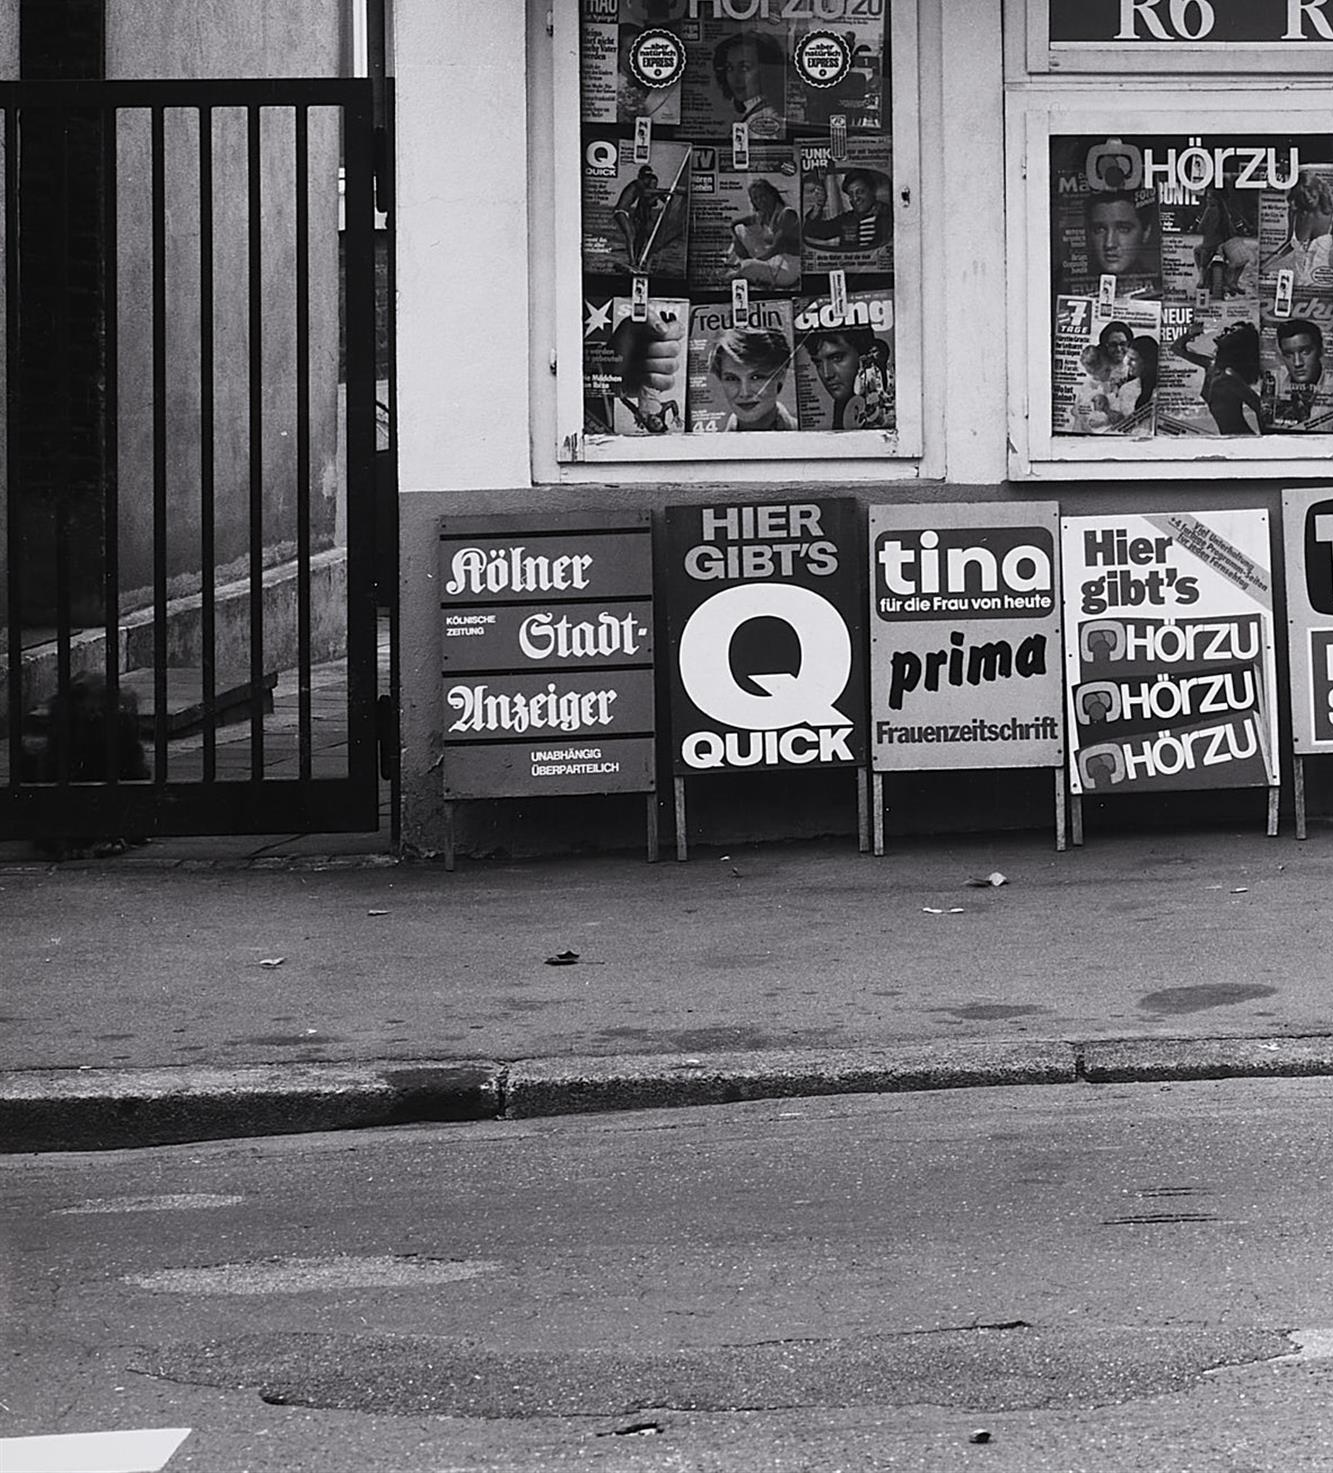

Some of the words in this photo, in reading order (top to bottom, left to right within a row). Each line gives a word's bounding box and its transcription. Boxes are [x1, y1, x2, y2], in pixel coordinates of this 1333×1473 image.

[690, 302, 783, 337] freudin
[1060, 325, 1088, 334] TAGE
[702, 503, 825, 542] HIER
[684, 540, 839, 581] GIBT'S
[879, 530, 1051, 596] tina
[1083, 529, 1173, 567] Hier
[446, 547, 593, 595] Kölner
[880, 597, 904, 613] für
[905, 596, 930, 612] die
[933, 596, 969, 612] Frau
[972, 597, 1001, 610] von
[1004, 594, 1052, 609] heute
[1081, 568, 1200, 616] gibt's
[446, 614, 496, 626] KÖLNISCHE
[446, 626, 485, 637] ZEITUNG
[519, 611, 648, 660] Stadt-
[679, 582, 855, 730] Q
[887, 631, 1048, 710] prima
[447, 682, 618, 733] Anzeiger
[681, 728, 856, 769] QUICK
[876, 717, 1059, 745] Frauenzeitschrift
[531, 747, 602, 762] UNABHÄNGIG
[531, 762, 620, 776] ÜBERPARTEILICH
